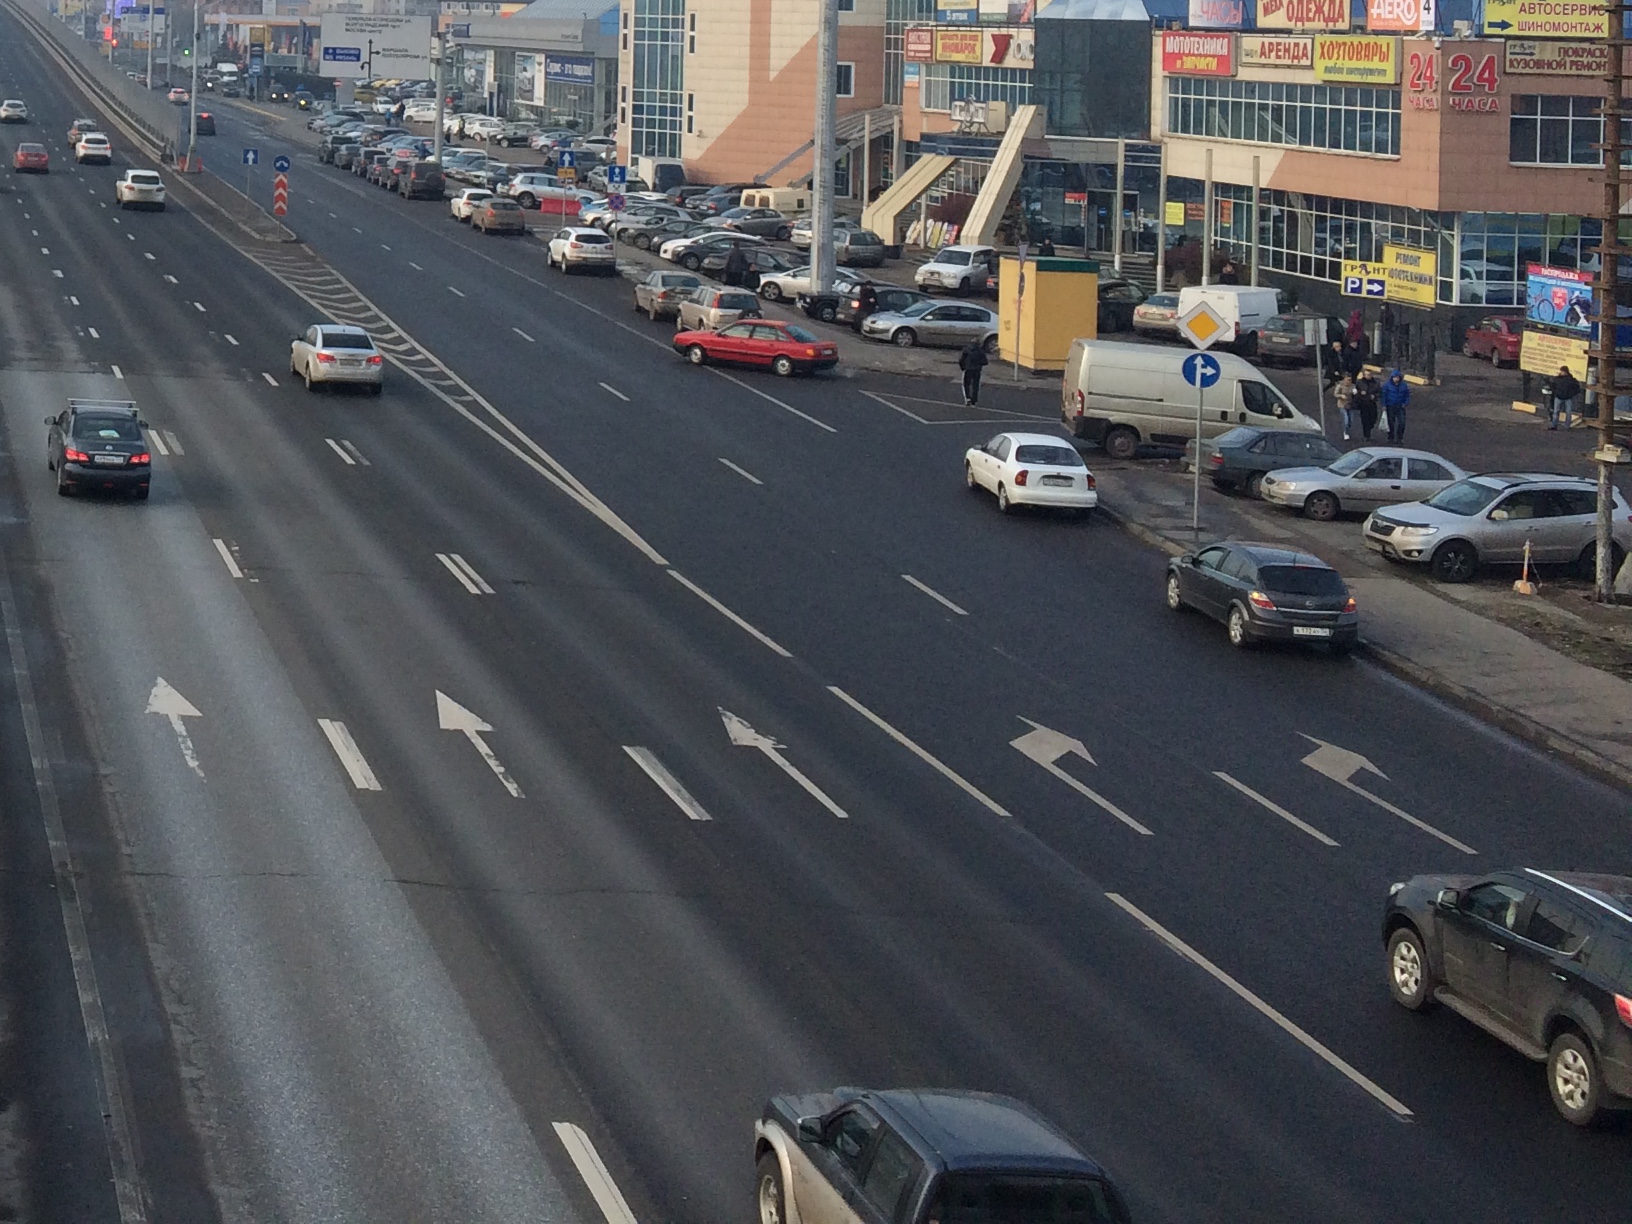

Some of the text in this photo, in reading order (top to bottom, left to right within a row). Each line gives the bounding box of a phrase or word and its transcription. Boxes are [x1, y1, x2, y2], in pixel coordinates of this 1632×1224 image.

[1200, 0, 1243, 25] ЧАСЫ
[1518, 2, 1606, 17] АВТОСЕРВИС
[1517, 20, 1605, 34] ШИНОМОНТАЖ
[1165, 36, 1229, 56] МОТОТЕХНИКА
[1259, 41, 1309, 64] АРЕНДА
[1319, 39, 1391, 63] ХОЗТОВАРЫ
[1557, 46, 1608, 59] ПОКРАСК
[1509, 57, 1567, 71] КУЗОВНОЙ
[1409, 52, 1436, 92] 24
[1449, 53, 1499, 93] 24
[1408, 96, 1437, 111] ЧАСА
[1449, 97, 1500, 112] ЧАСА
[1343, 264, 1388, 276] ГРАНТ
